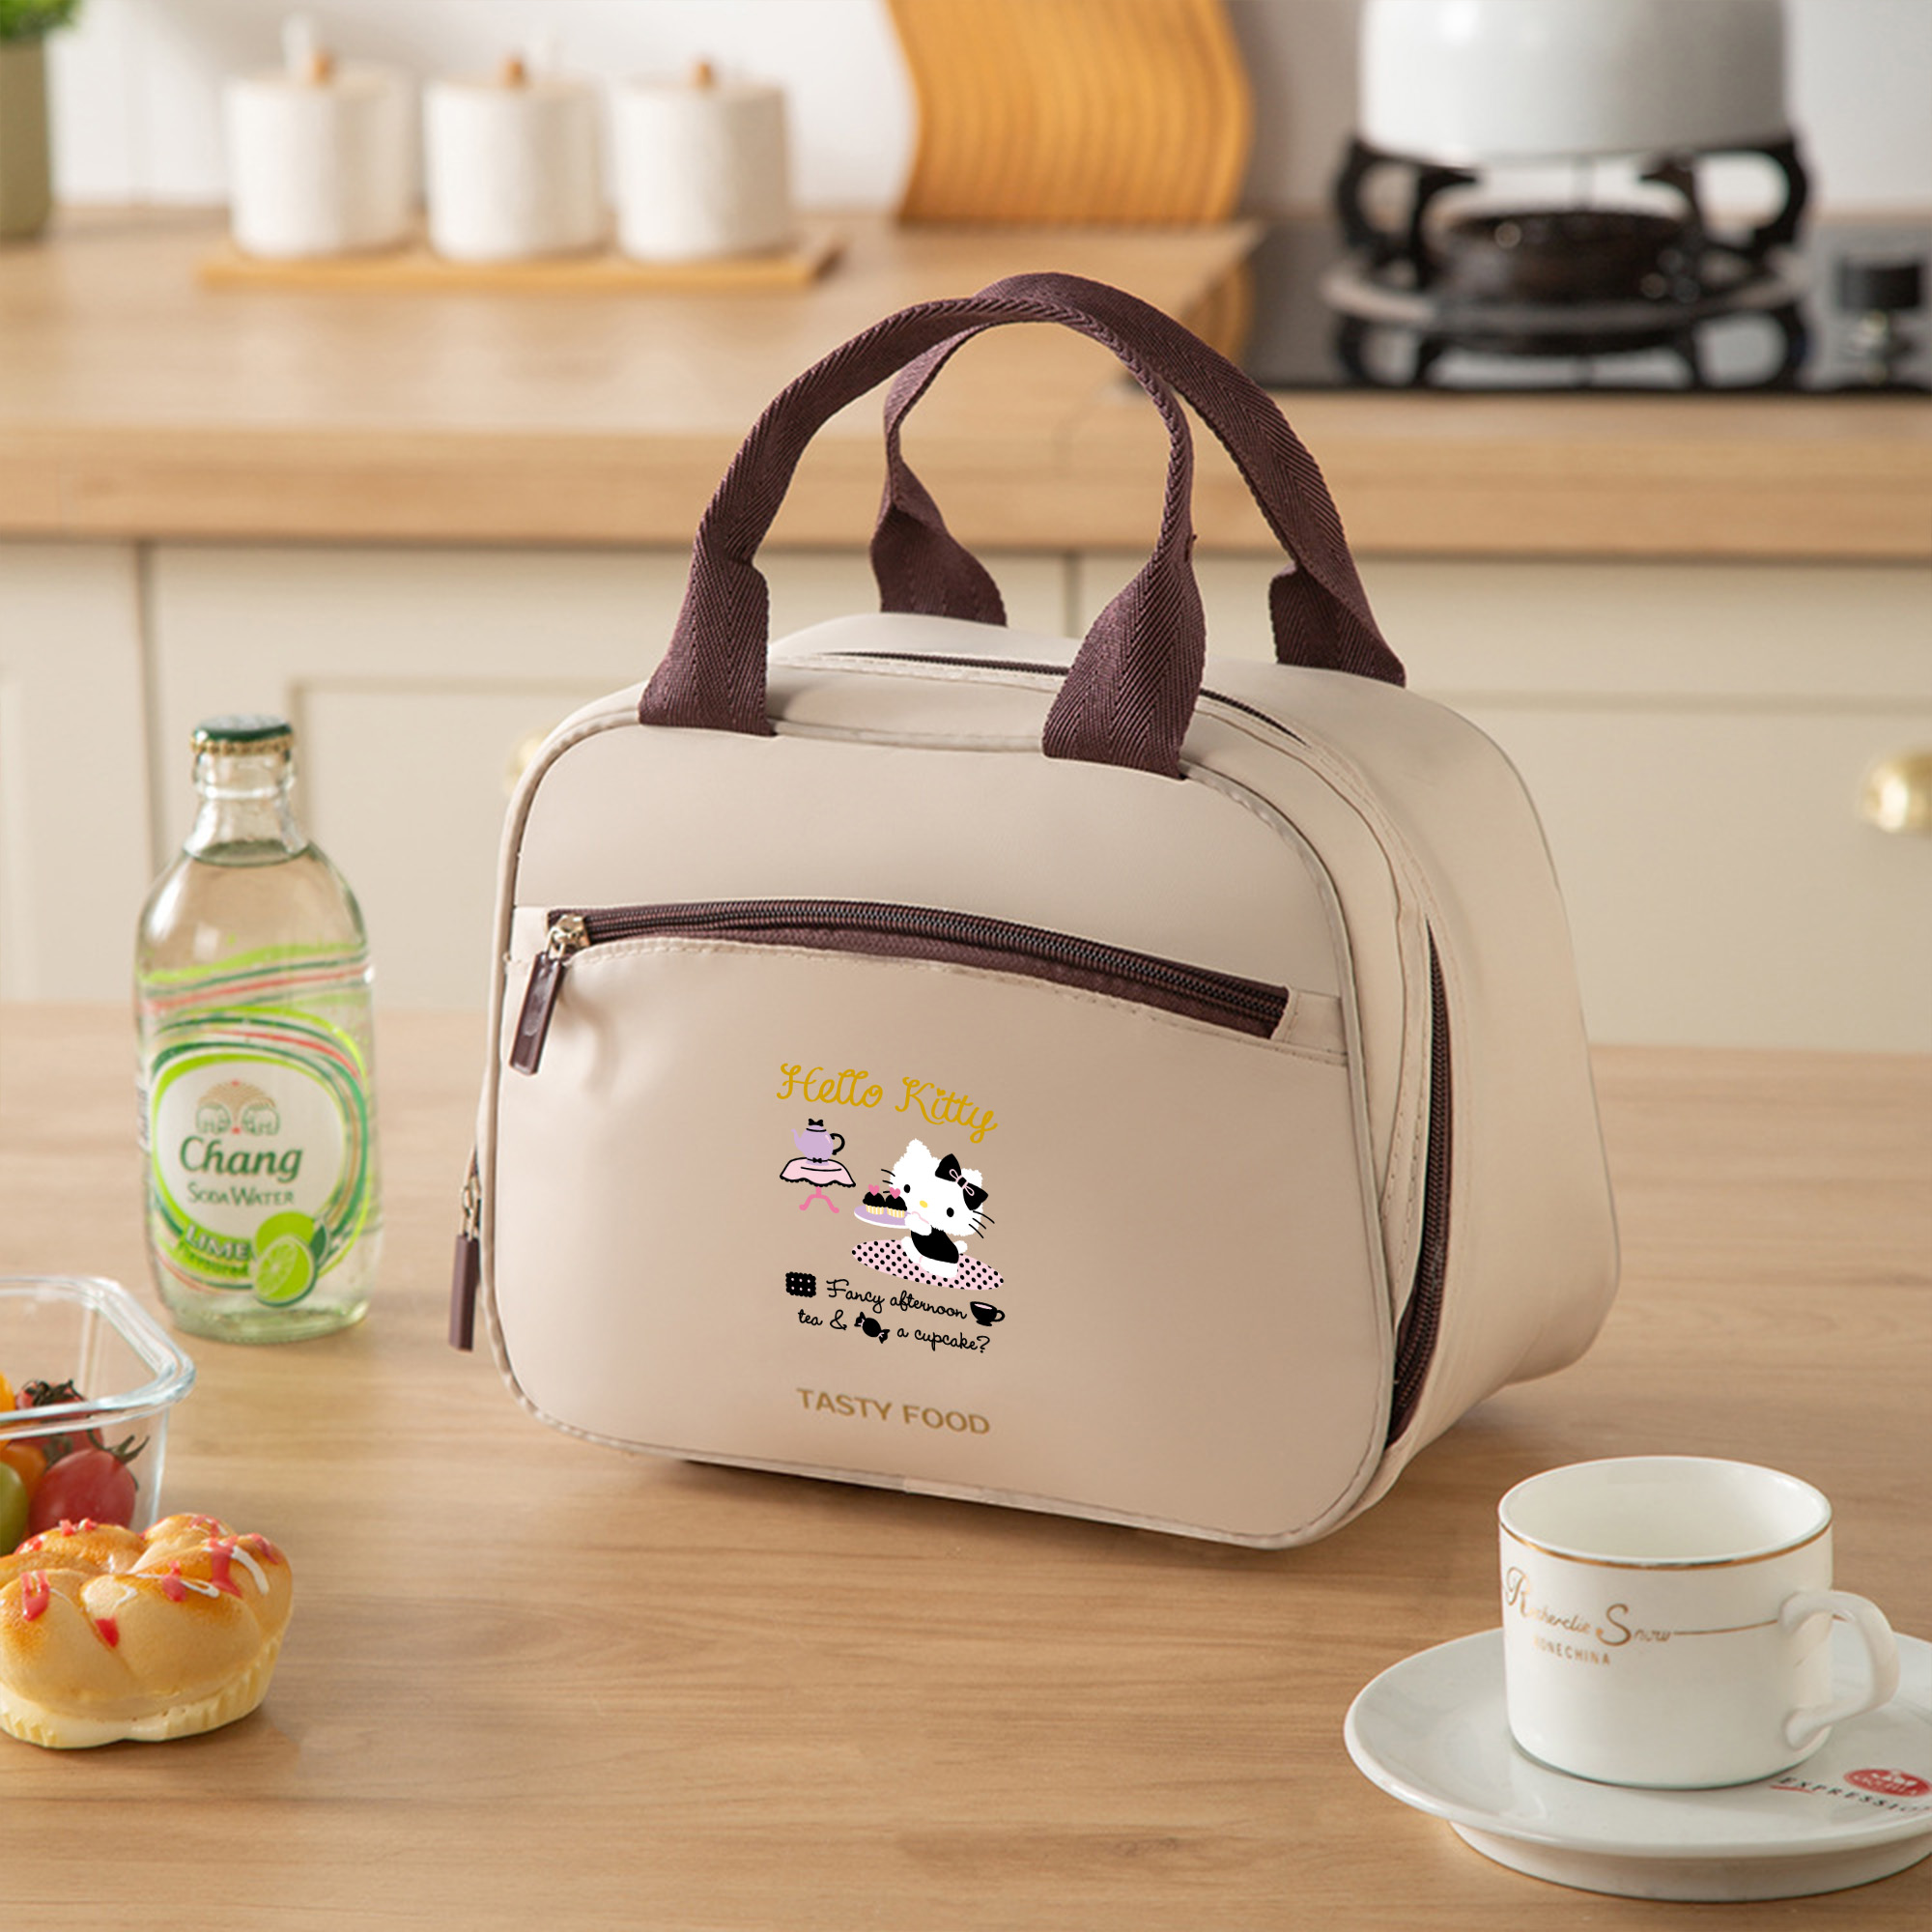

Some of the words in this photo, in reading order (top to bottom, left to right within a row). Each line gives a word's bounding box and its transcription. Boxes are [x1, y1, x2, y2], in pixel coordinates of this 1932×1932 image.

[777, 1063, 883, 1108] Hello
[895, 1076, 999, 1144] Kitty
[180, 1136, 303, 1183] Chang
[185, 1223, 250, 1262] LIME
[826, 1278, 886, 1314] Fancy
[890, 1290, 968, 1320] afternoon
[797, 1309, 823, 1326] tea
[829, 1309, 847, 1331] &
[896, 1327, 909, 1338] a
[914, 1328, 990, 1353] cupcake?
[796, 1387, 893, 1422] TASTY
[902, 1404, 990, 1435] FOOD
